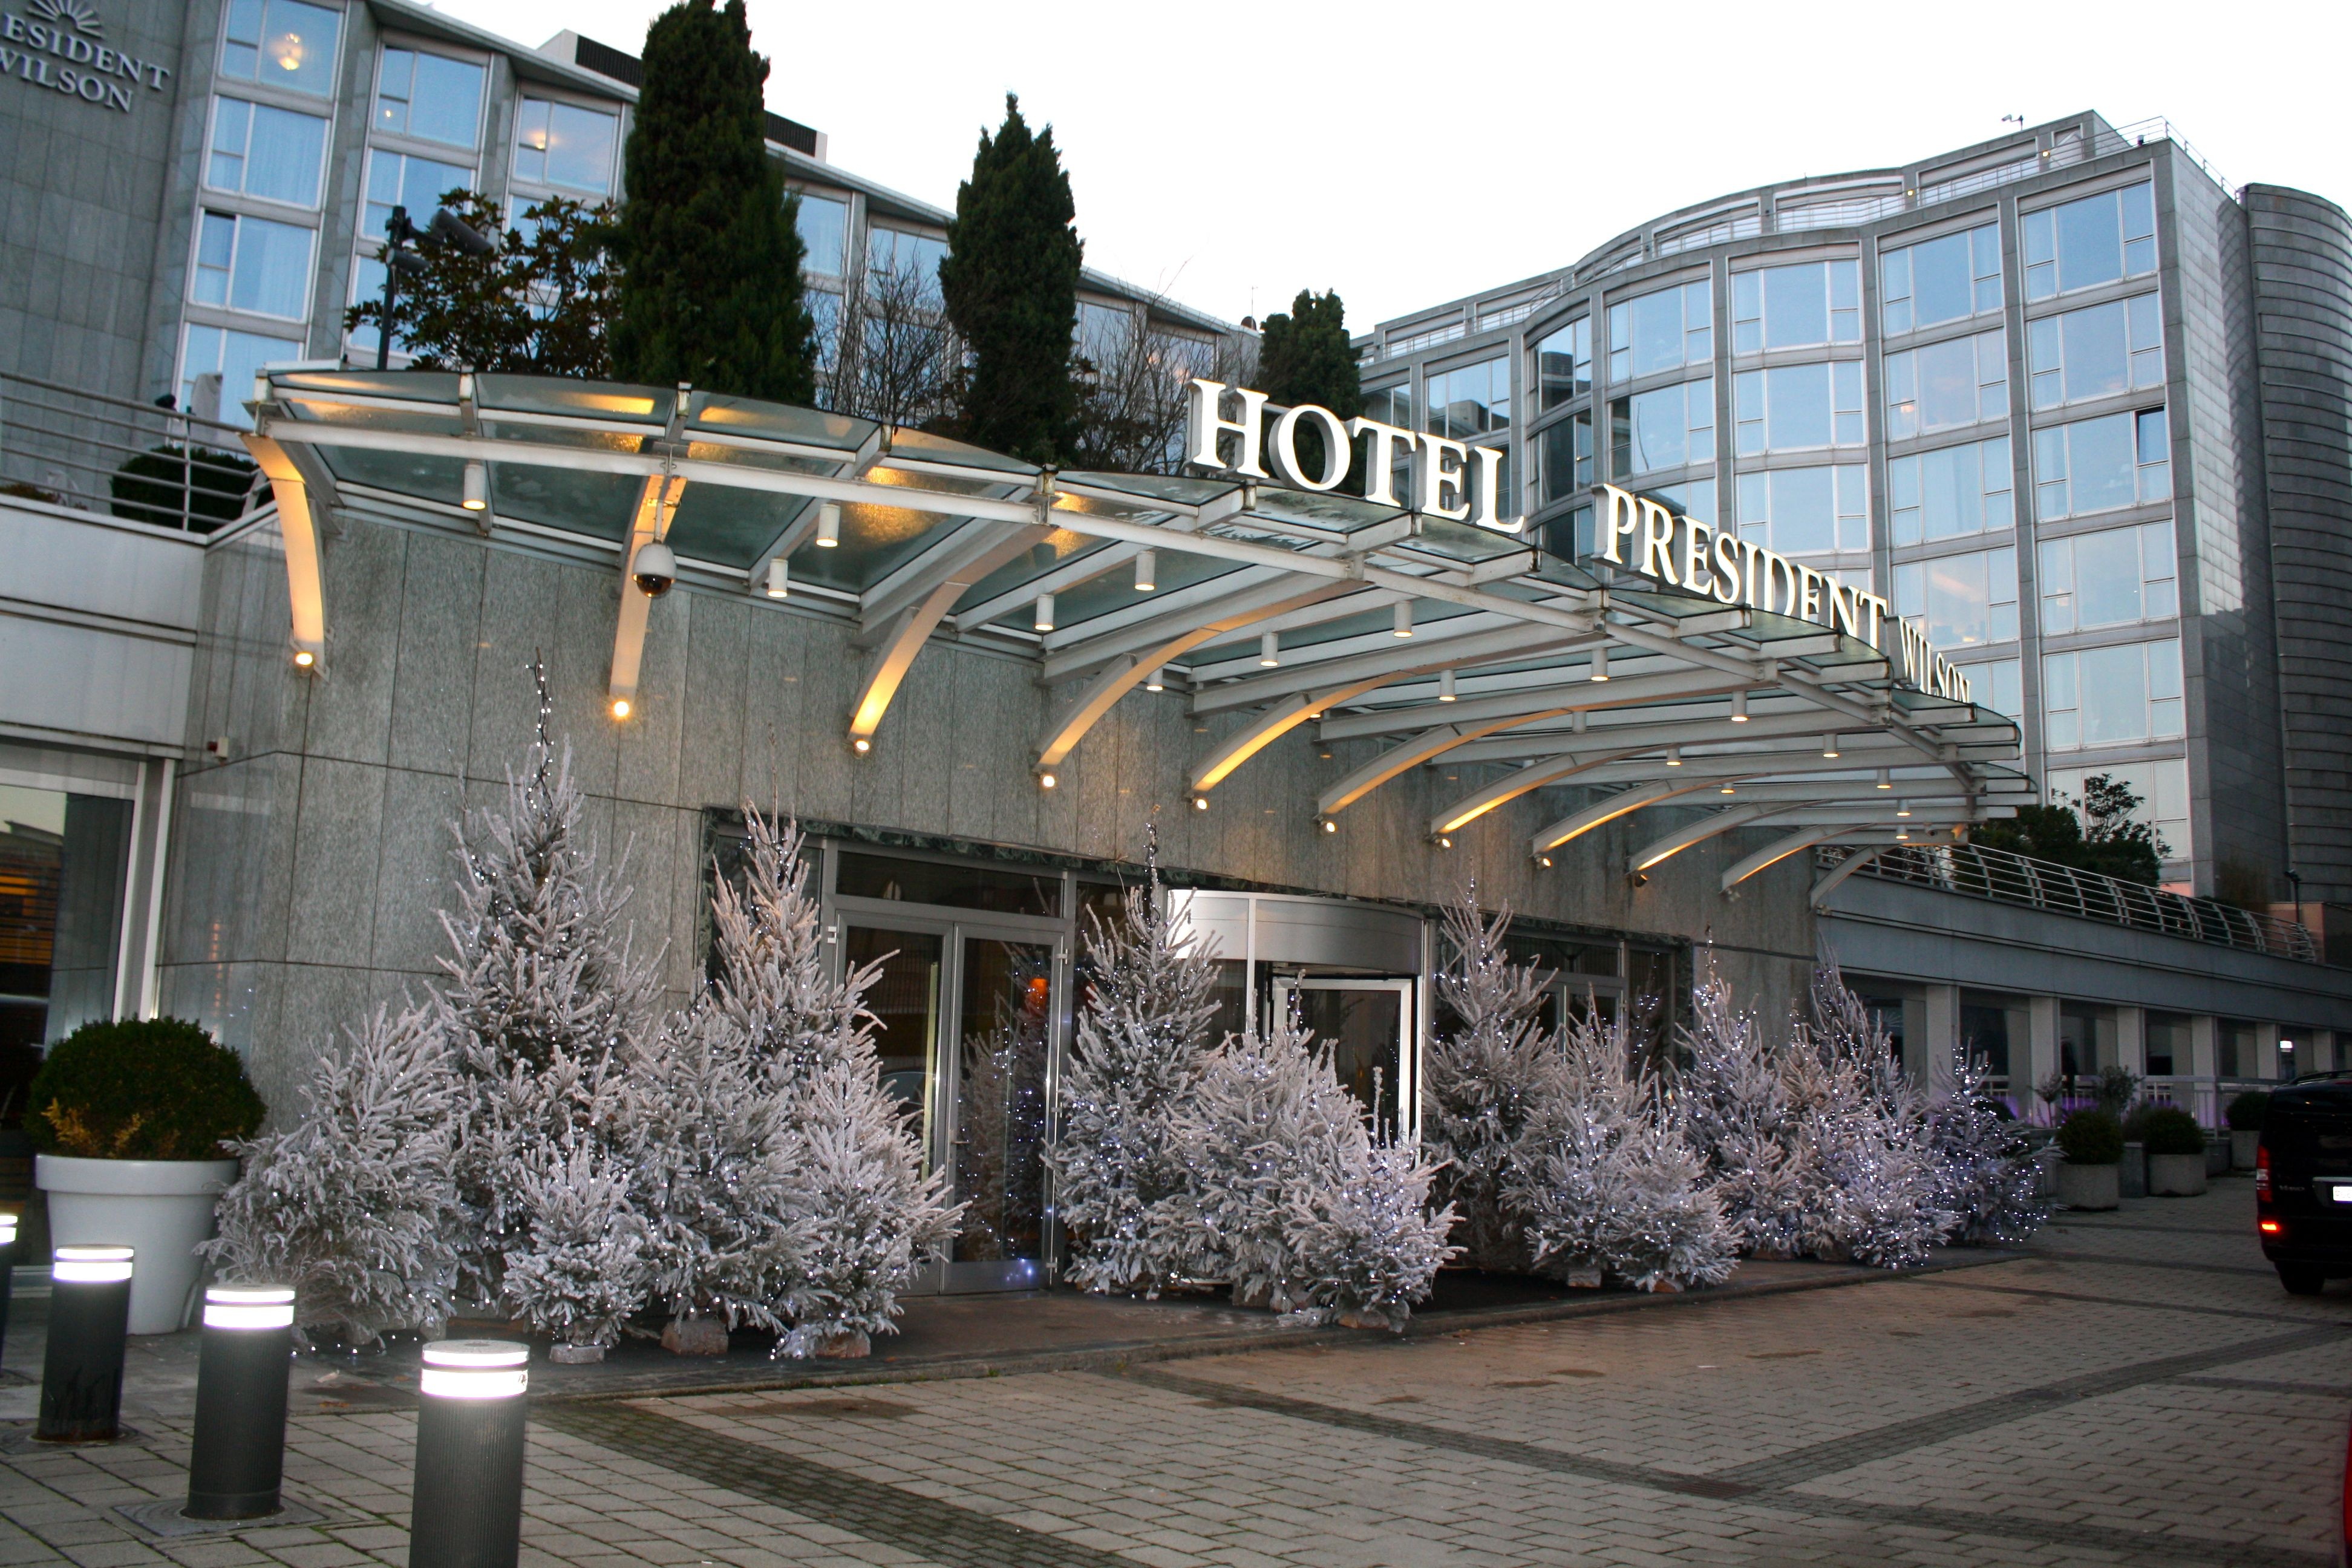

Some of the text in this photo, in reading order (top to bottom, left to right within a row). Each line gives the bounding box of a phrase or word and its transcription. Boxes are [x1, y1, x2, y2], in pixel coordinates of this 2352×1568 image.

[1191, 378, 1524, 534] HOTEL
[1602, 483, 1970, 703] PRESIDENT WILSON
